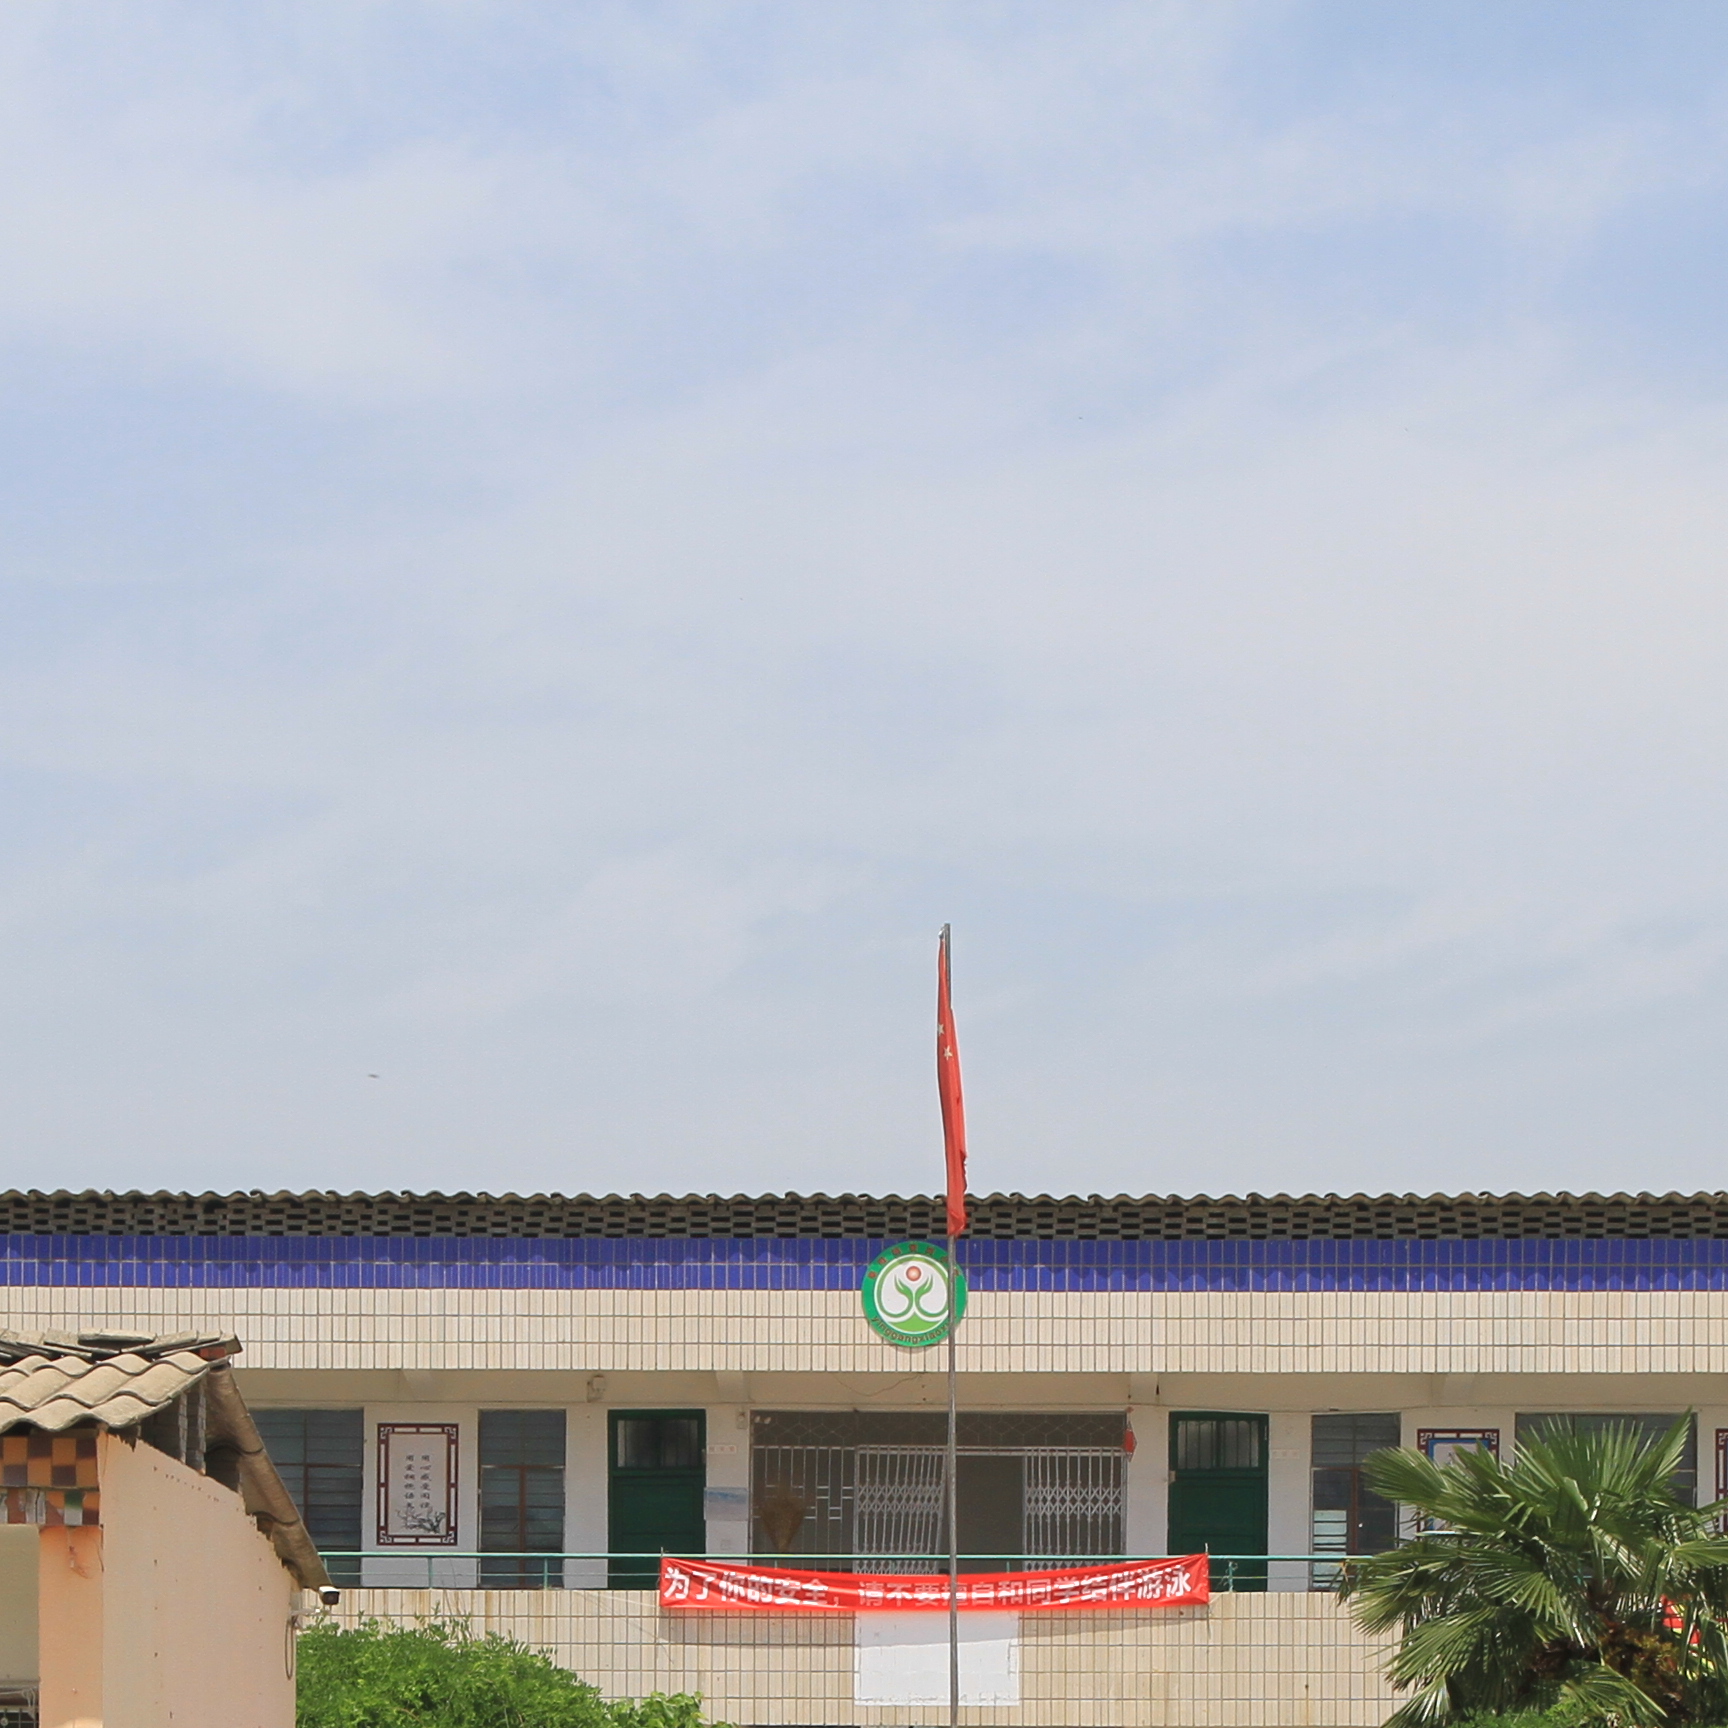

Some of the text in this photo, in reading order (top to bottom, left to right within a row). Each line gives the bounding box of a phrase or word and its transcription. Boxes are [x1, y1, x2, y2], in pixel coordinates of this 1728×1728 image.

[871, 1315, 953, 1345] yinggangxiaox
[663, 1565, 1191, 1607] 为了你的安全，请不要擅自和同学结伴游泳
